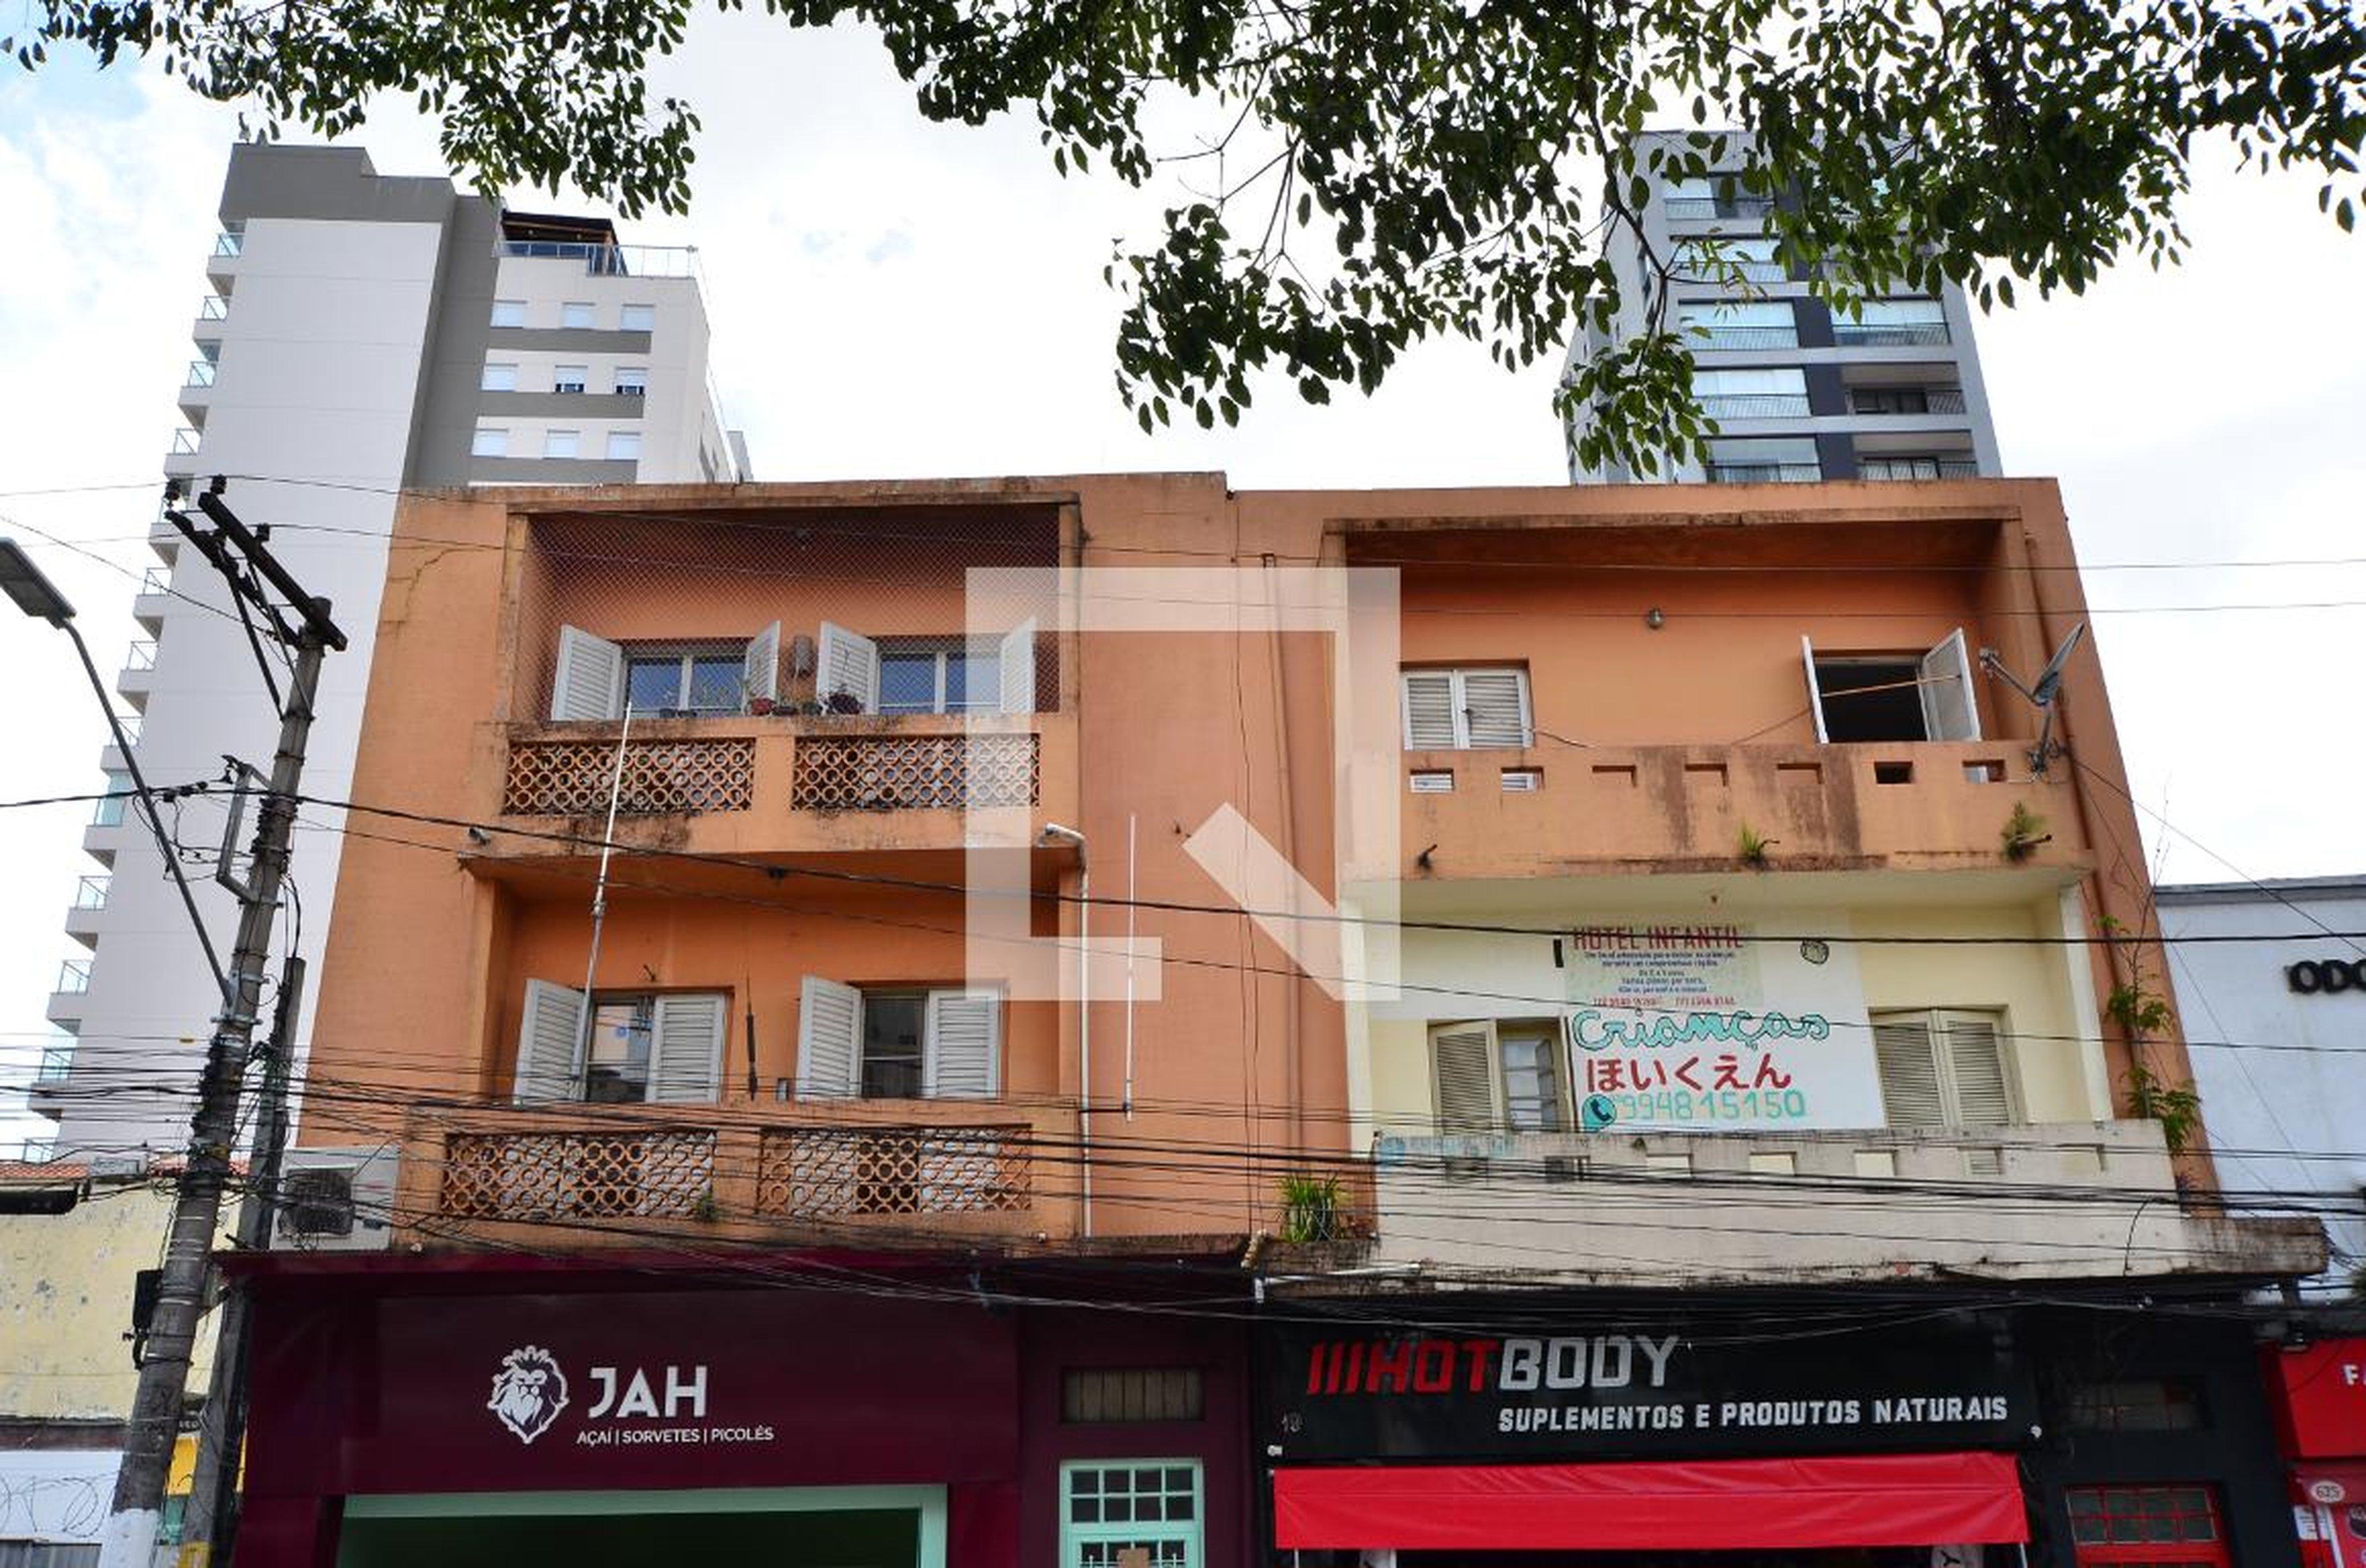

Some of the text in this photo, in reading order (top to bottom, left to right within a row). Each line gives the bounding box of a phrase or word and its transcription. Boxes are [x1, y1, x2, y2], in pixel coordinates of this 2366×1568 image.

[1574, 926, 1743, 949] HOTEL INFANTIL
[1572, 1010, 1830, 1050] Crianças
[1587, 1053, 1792, 1092] ほいくえん
[588, 1365, 708, 1418] JAH
[1498, 1397, 2008, 1432] SUPLEMENTOS E PRODUTOS NATURAIS
[576, 1424, 775, 1447] AÇAÍ SORVETES PICOLÉS
